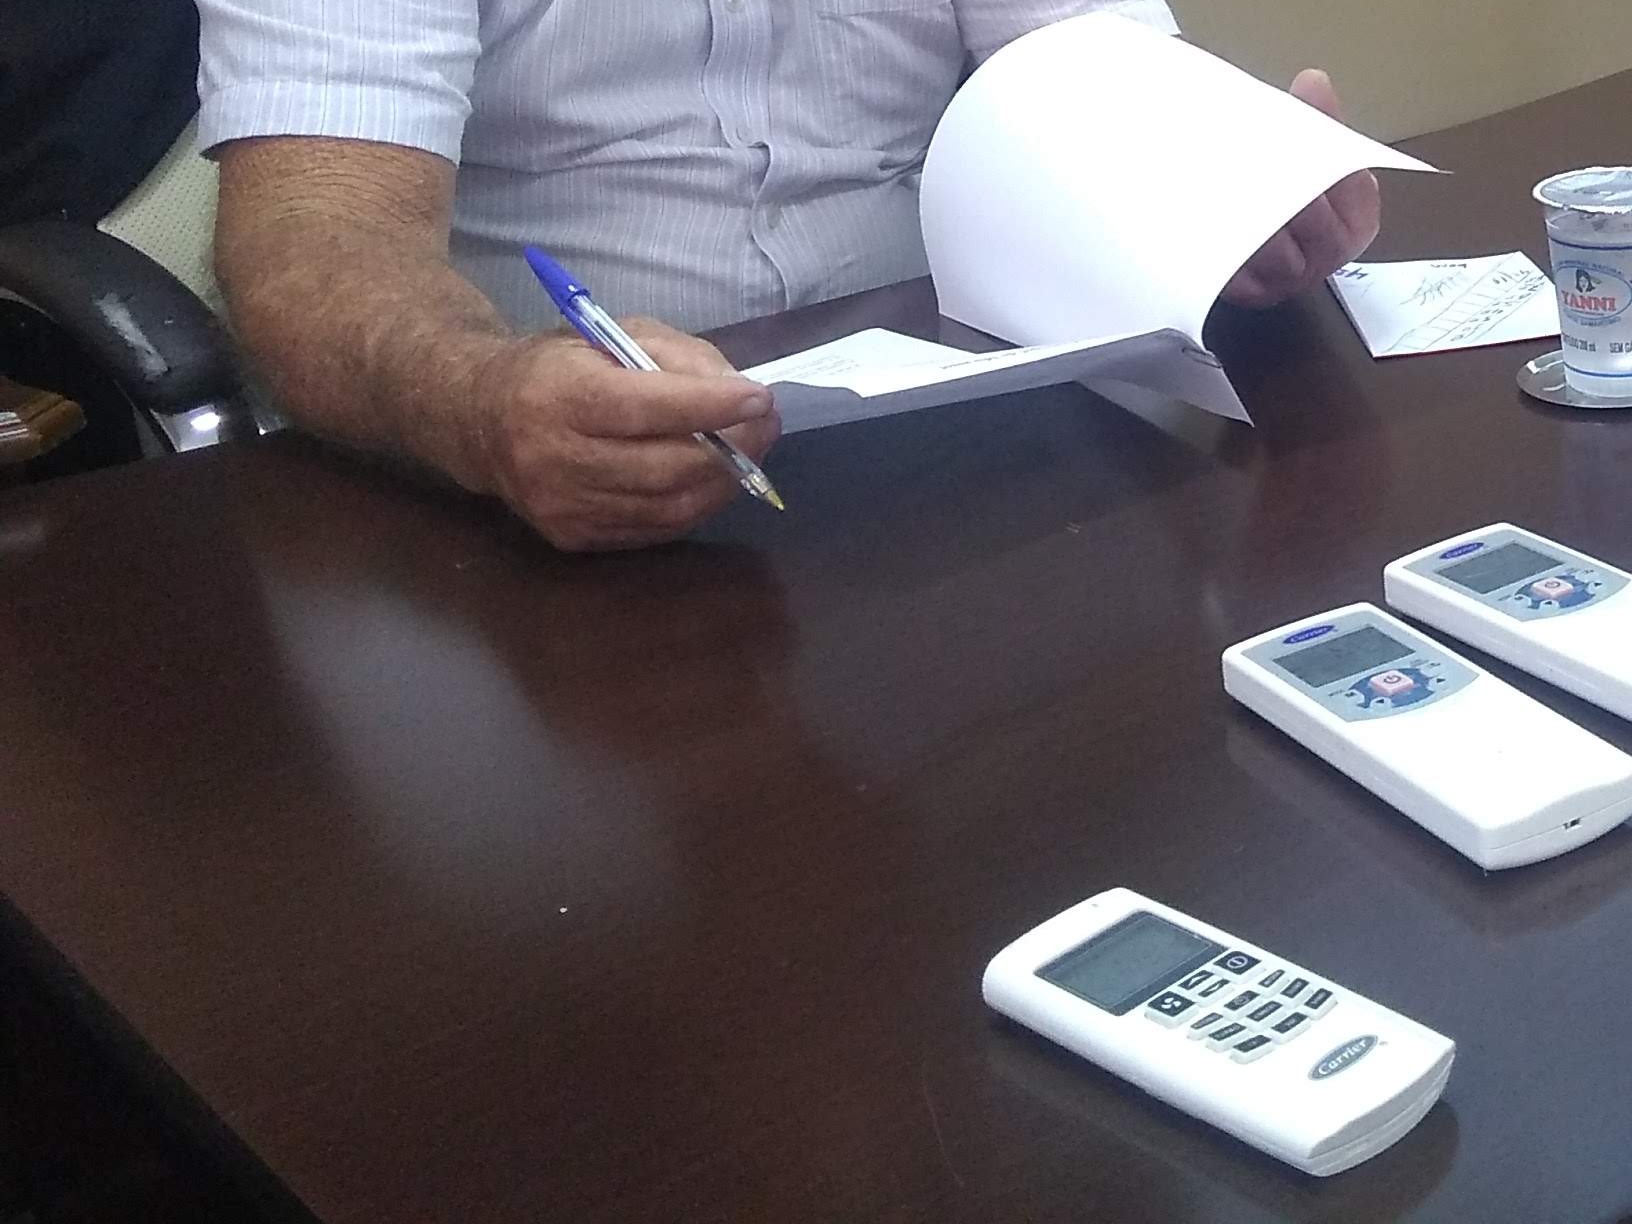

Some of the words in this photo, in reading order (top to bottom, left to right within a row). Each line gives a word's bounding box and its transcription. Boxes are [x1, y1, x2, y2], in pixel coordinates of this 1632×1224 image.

[1560, 290, 1616, 312] YANNI
[1609, 342, 1623, 353] SEM
[1318, 1038, 1368, 1075] Carrier
